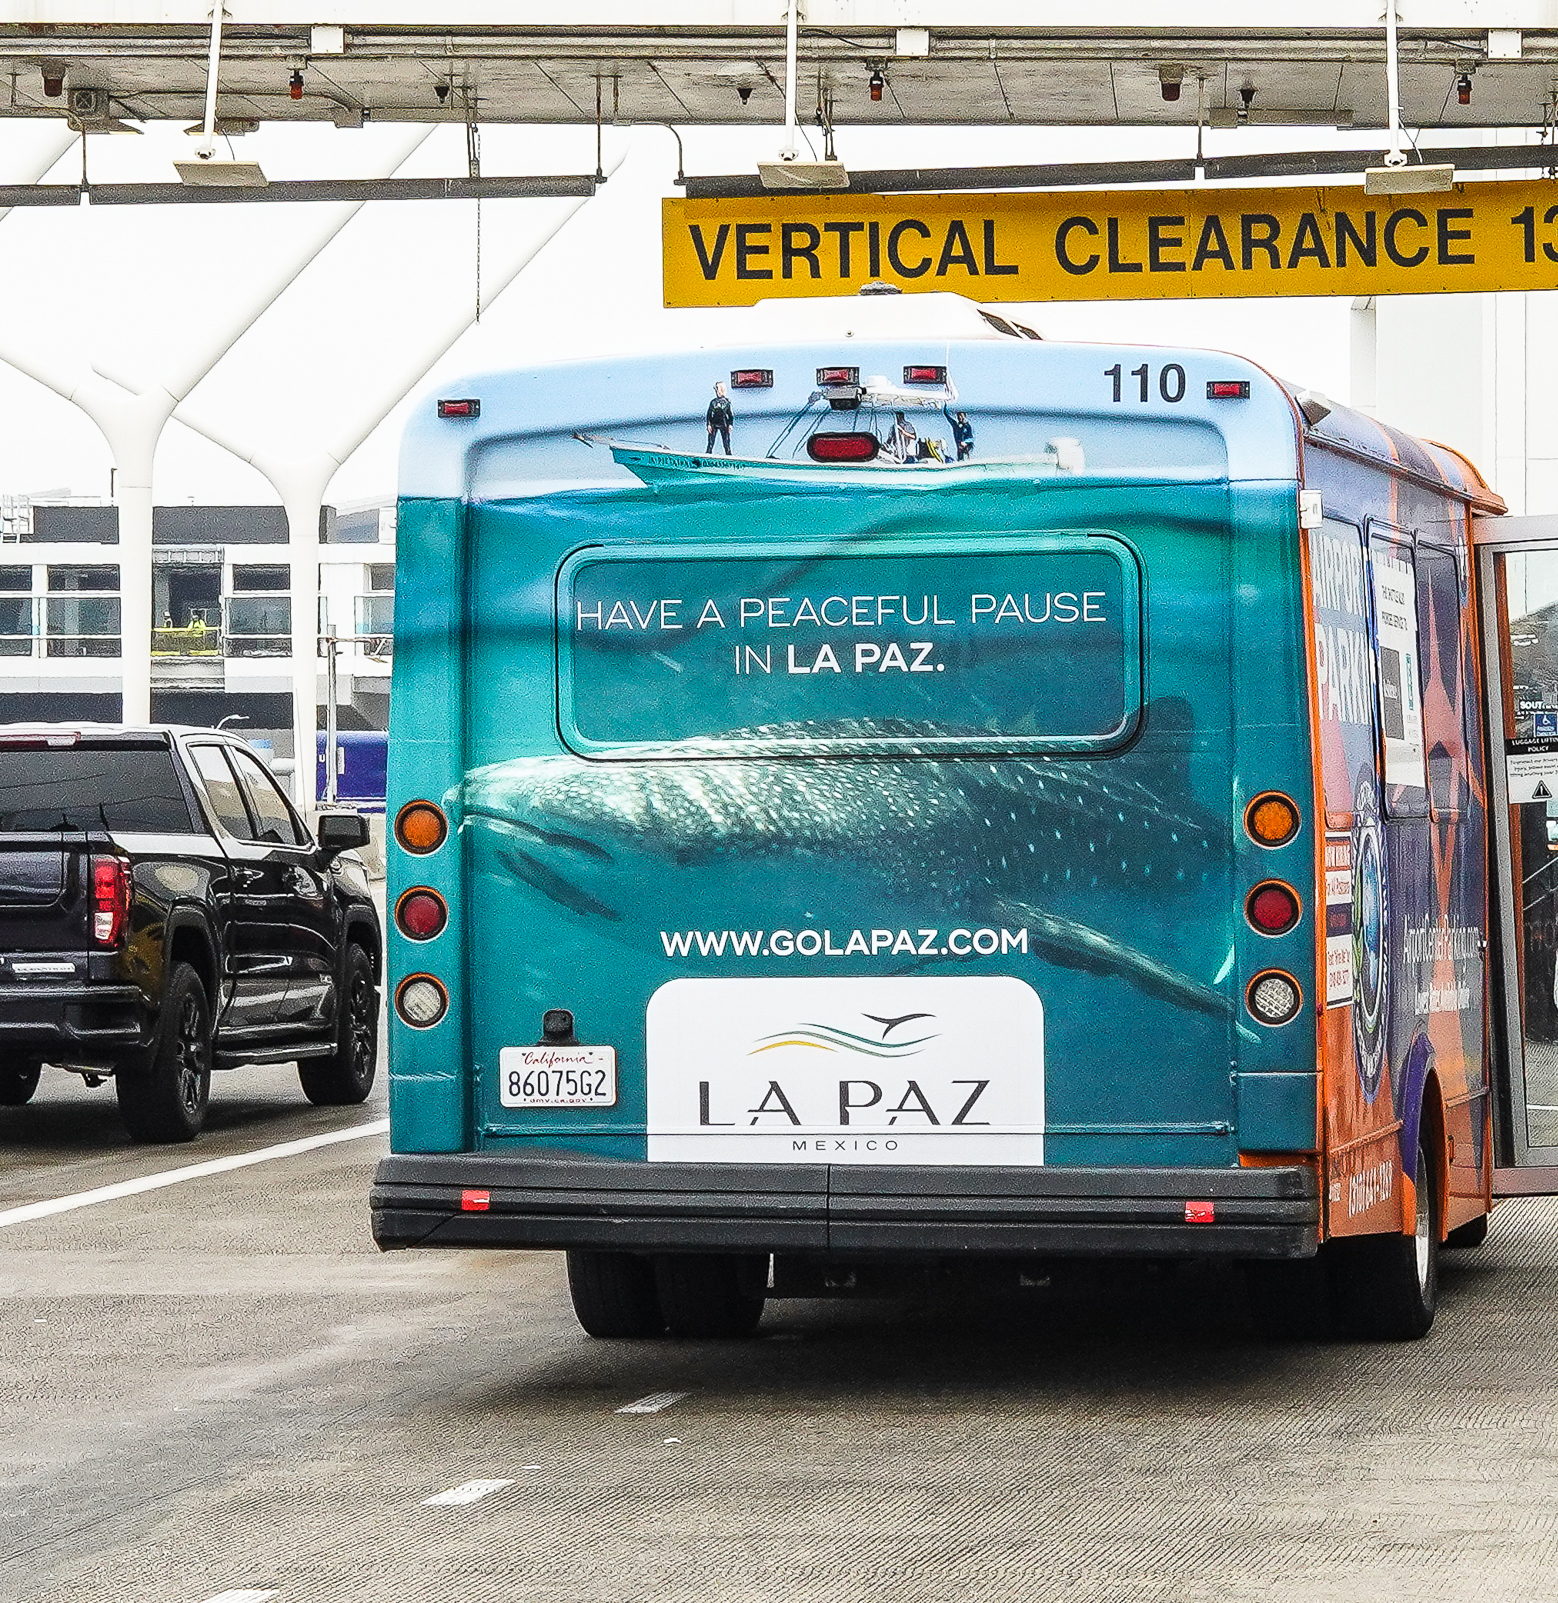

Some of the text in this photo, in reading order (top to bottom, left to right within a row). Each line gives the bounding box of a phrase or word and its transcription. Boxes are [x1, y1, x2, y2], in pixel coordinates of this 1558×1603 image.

[689, 219, 1019, 281] VERTICAL
[1055, 207, 1474, 275] CLEARANCE
[1104, 364, 1186, 403] 110
[577, 591, 1107, 631] HAVE A PEACEFUL PAUSE
[734, 640, 945, 675] IN LA PAZ.
[659, 927, 1028, 958] WWW.GOLAPAZ.COM
[525, 1051, 593, 1068] California
[508, 1069, 606, 1097] 86075G2
[698, 1079, 992, 1126] LA PAZ
[792, 1139, 899, 1152] MEXICO
